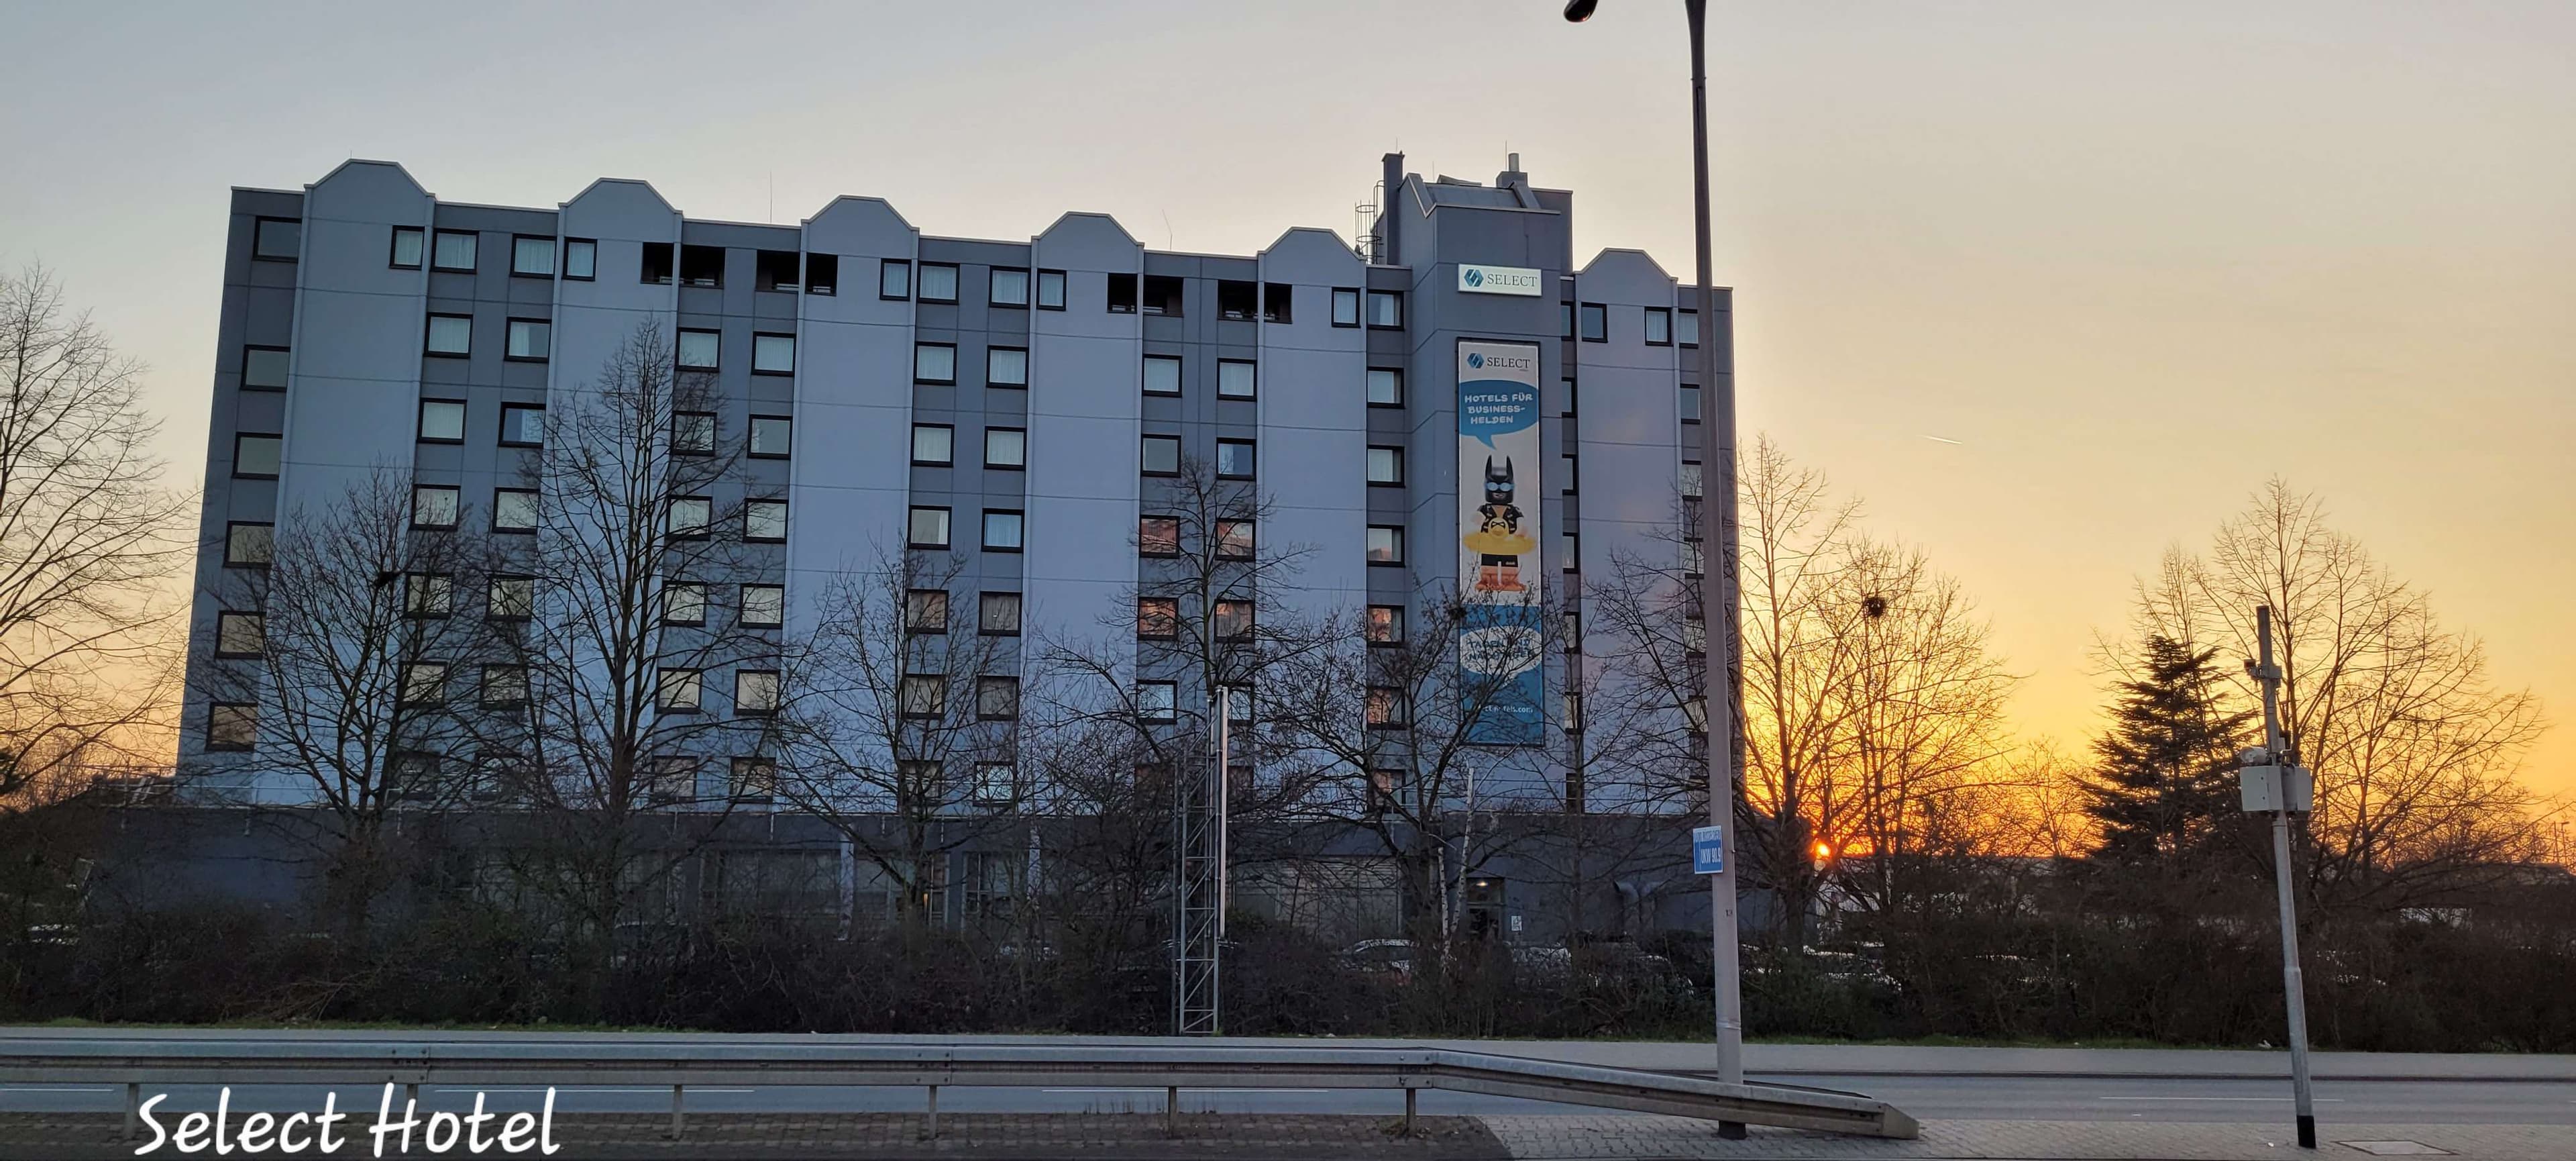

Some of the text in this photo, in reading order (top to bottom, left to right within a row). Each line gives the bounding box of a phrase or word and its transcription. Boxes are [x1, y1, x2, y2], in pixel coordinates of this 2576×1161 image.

[1487, 273, 1538, 287] SELECT
[1487, 356, 1531, 369] SELECT
[1464, 391, 1534, 403] HOTELS FÜR
[1467, 405, 1525, 414] BUSINESS-
[1470, 415, 1513, 425] HELDEN
[1701, 847, 1721, 864] UKW 90.9
